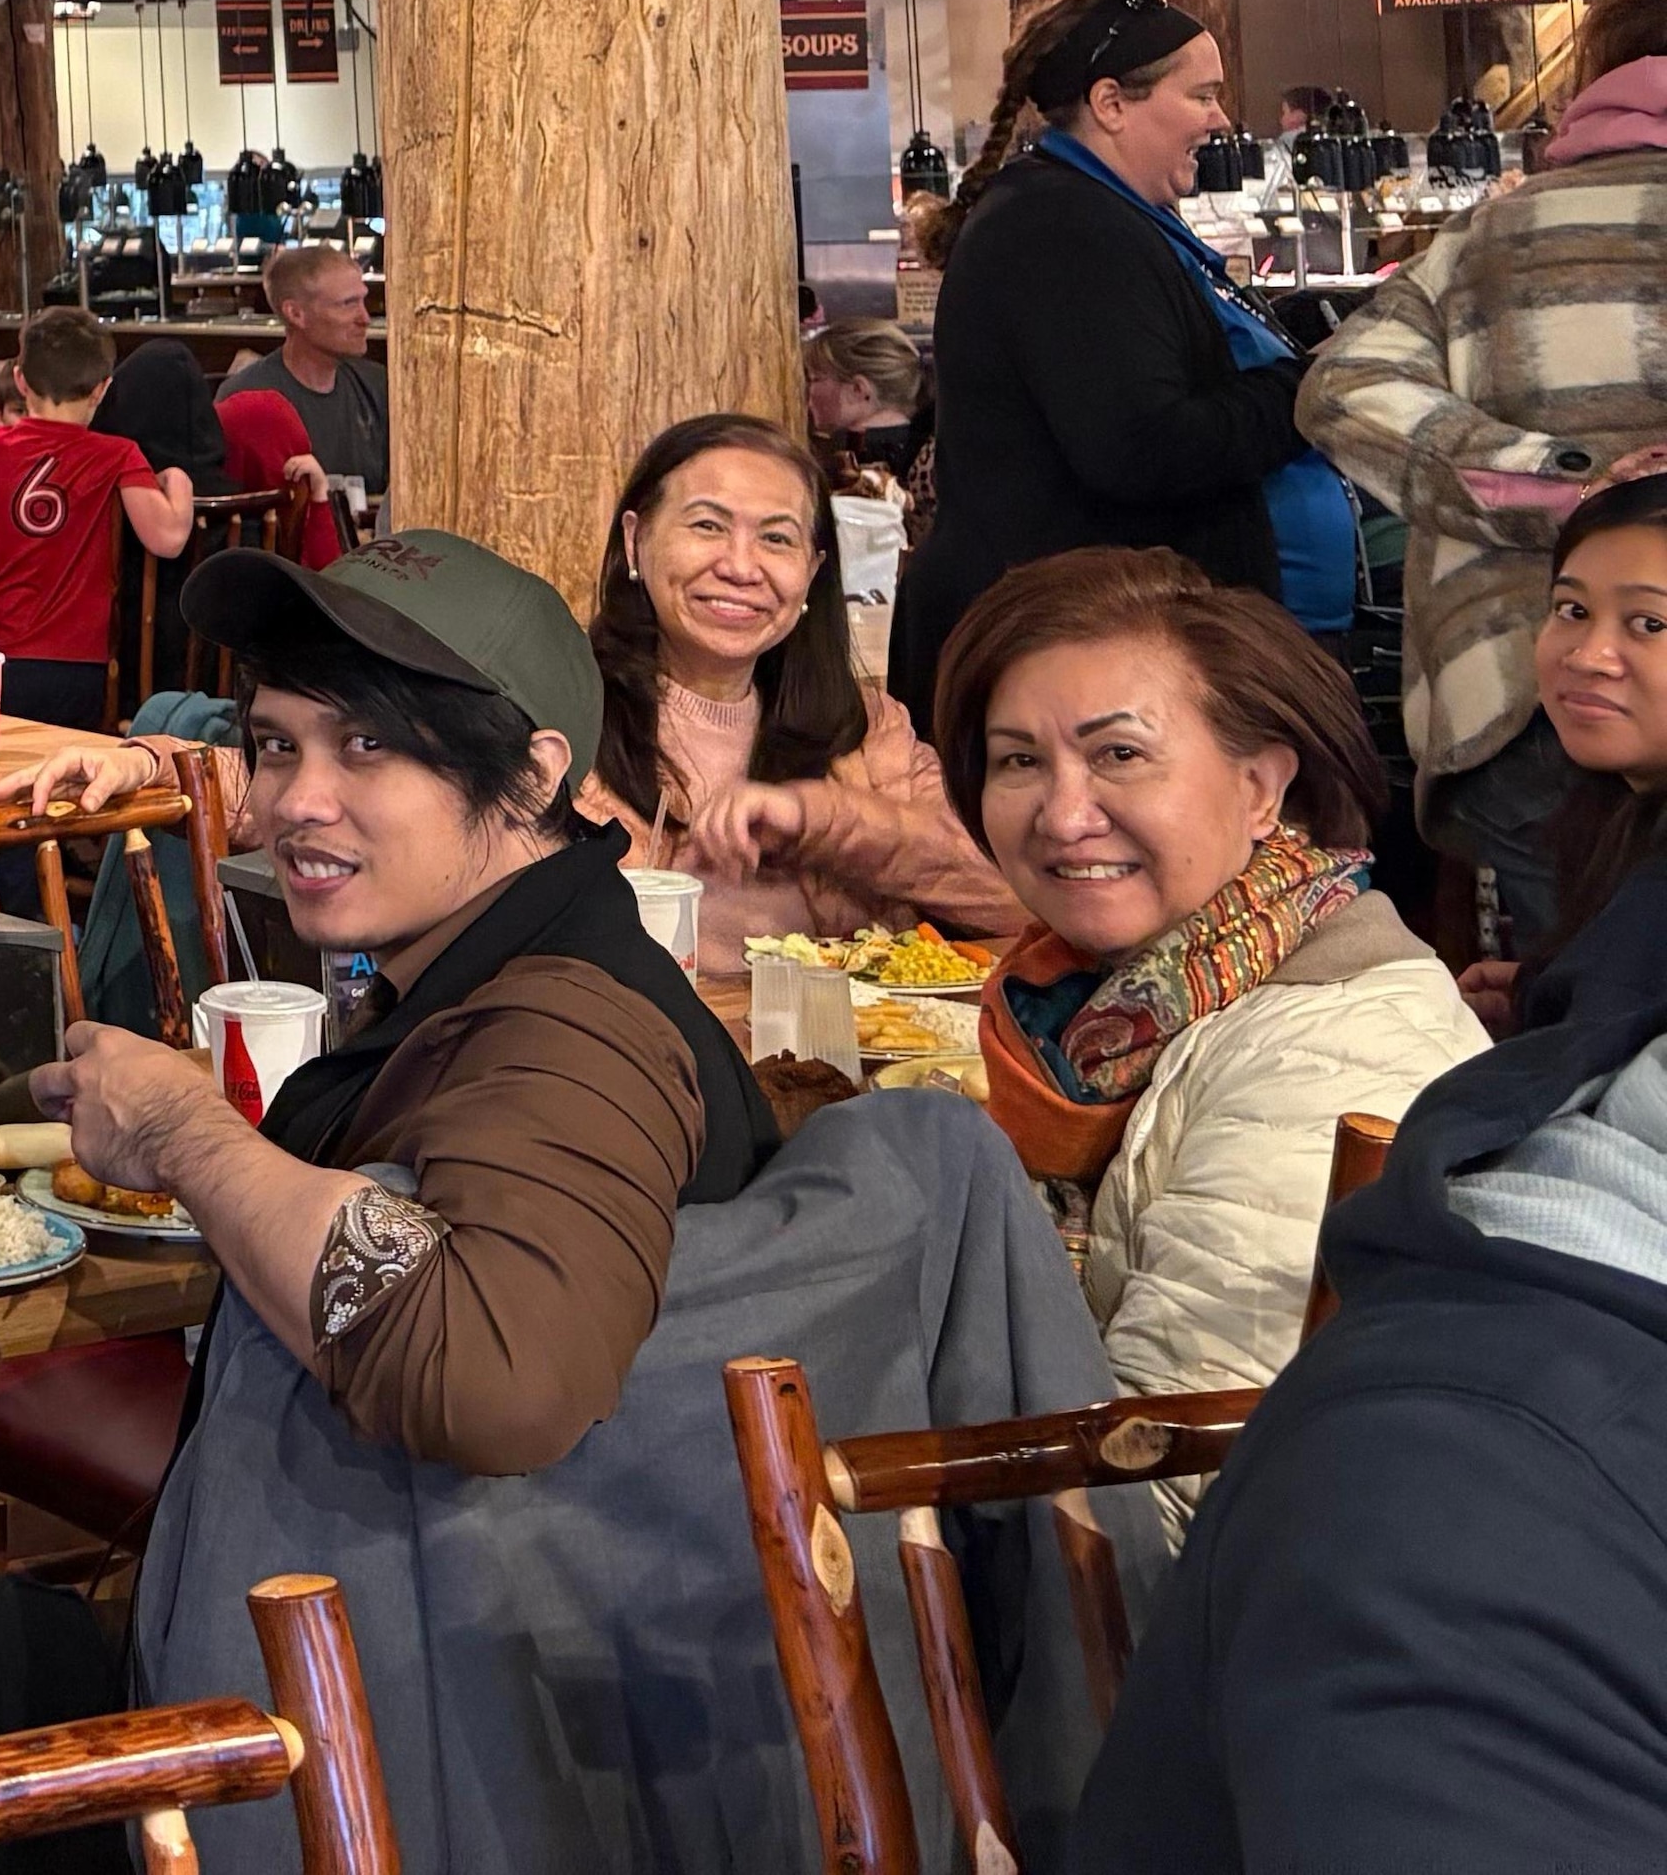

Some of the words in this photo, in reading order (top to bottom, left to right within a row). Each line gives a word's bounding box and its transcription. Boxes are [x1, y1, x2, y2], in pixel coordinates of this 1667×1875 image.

[289, 17, 331, 34] DRKS
[782, 33, 859, 57] SOUPS
[11, 453, 69, 539] 6
